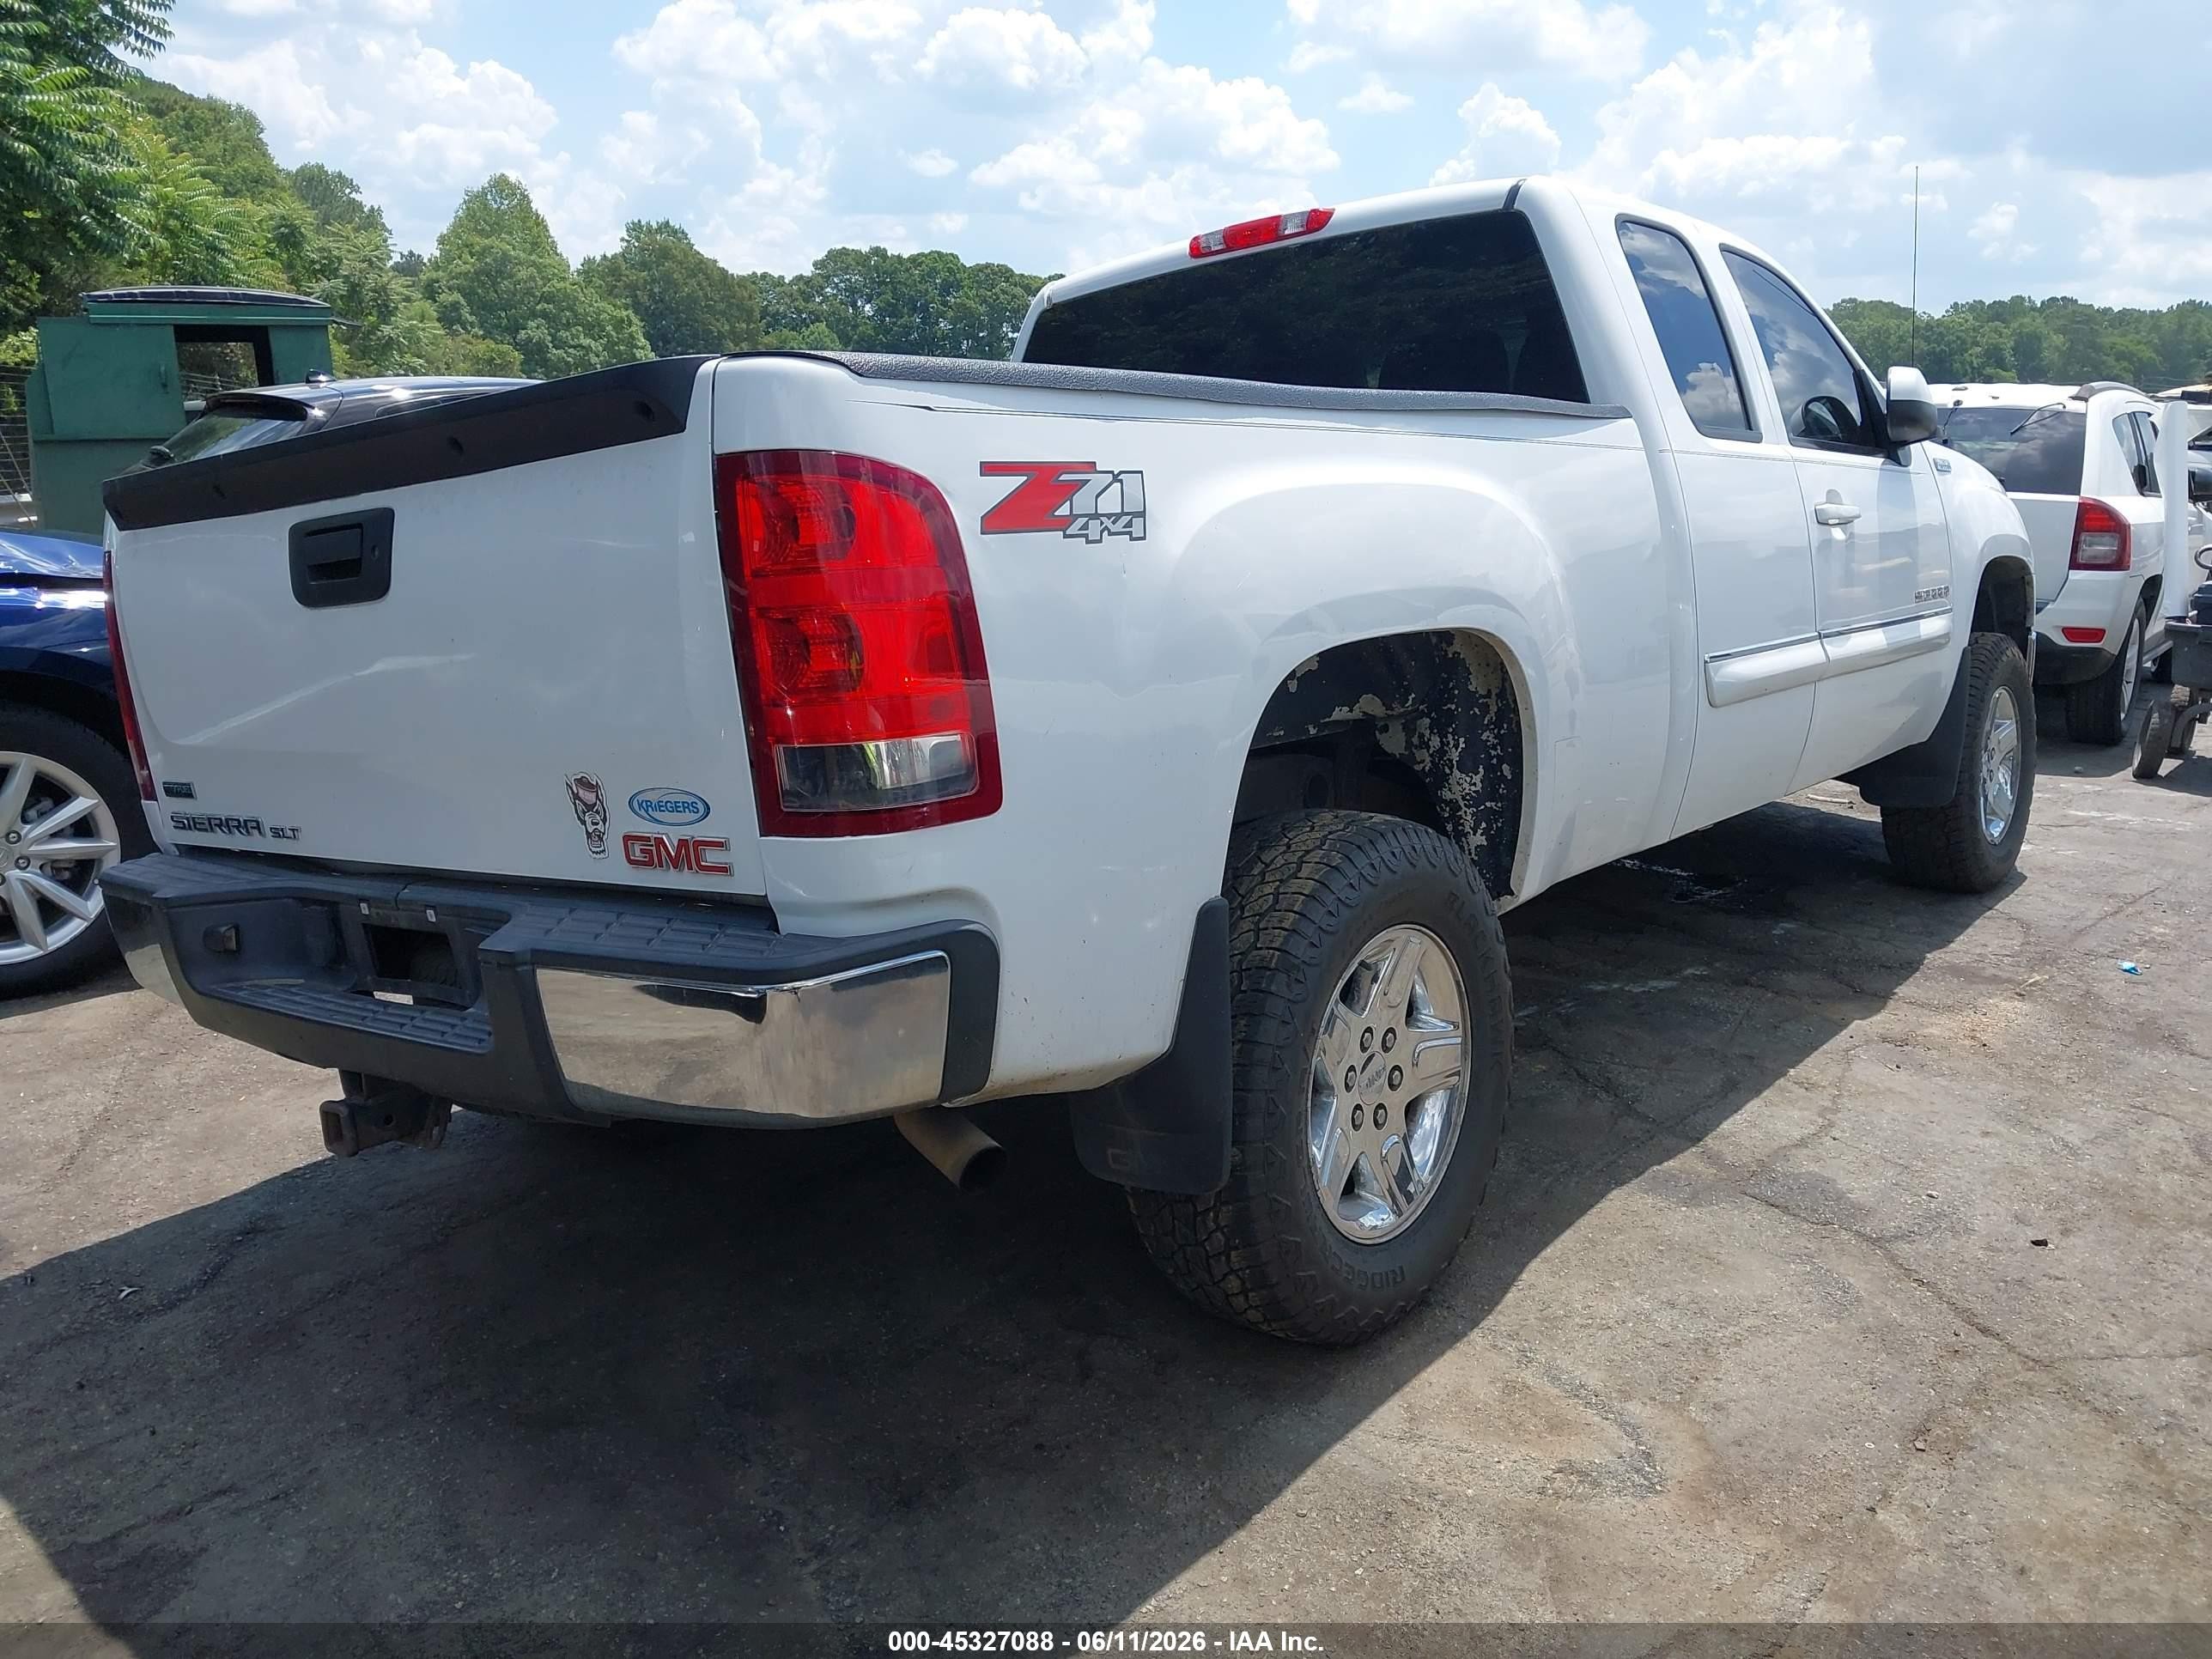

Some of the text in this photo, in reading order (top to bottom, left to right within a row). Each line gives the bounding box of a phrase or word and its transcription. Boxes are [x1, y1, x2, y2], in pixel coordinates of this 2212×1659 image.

[980, 461, 1146, 535] Z71
[637, 798, 700, 815] KRIEGERS
[171, 812, 301, 841] SIERRA SLT
[622, 831, 734, 878] GMC
